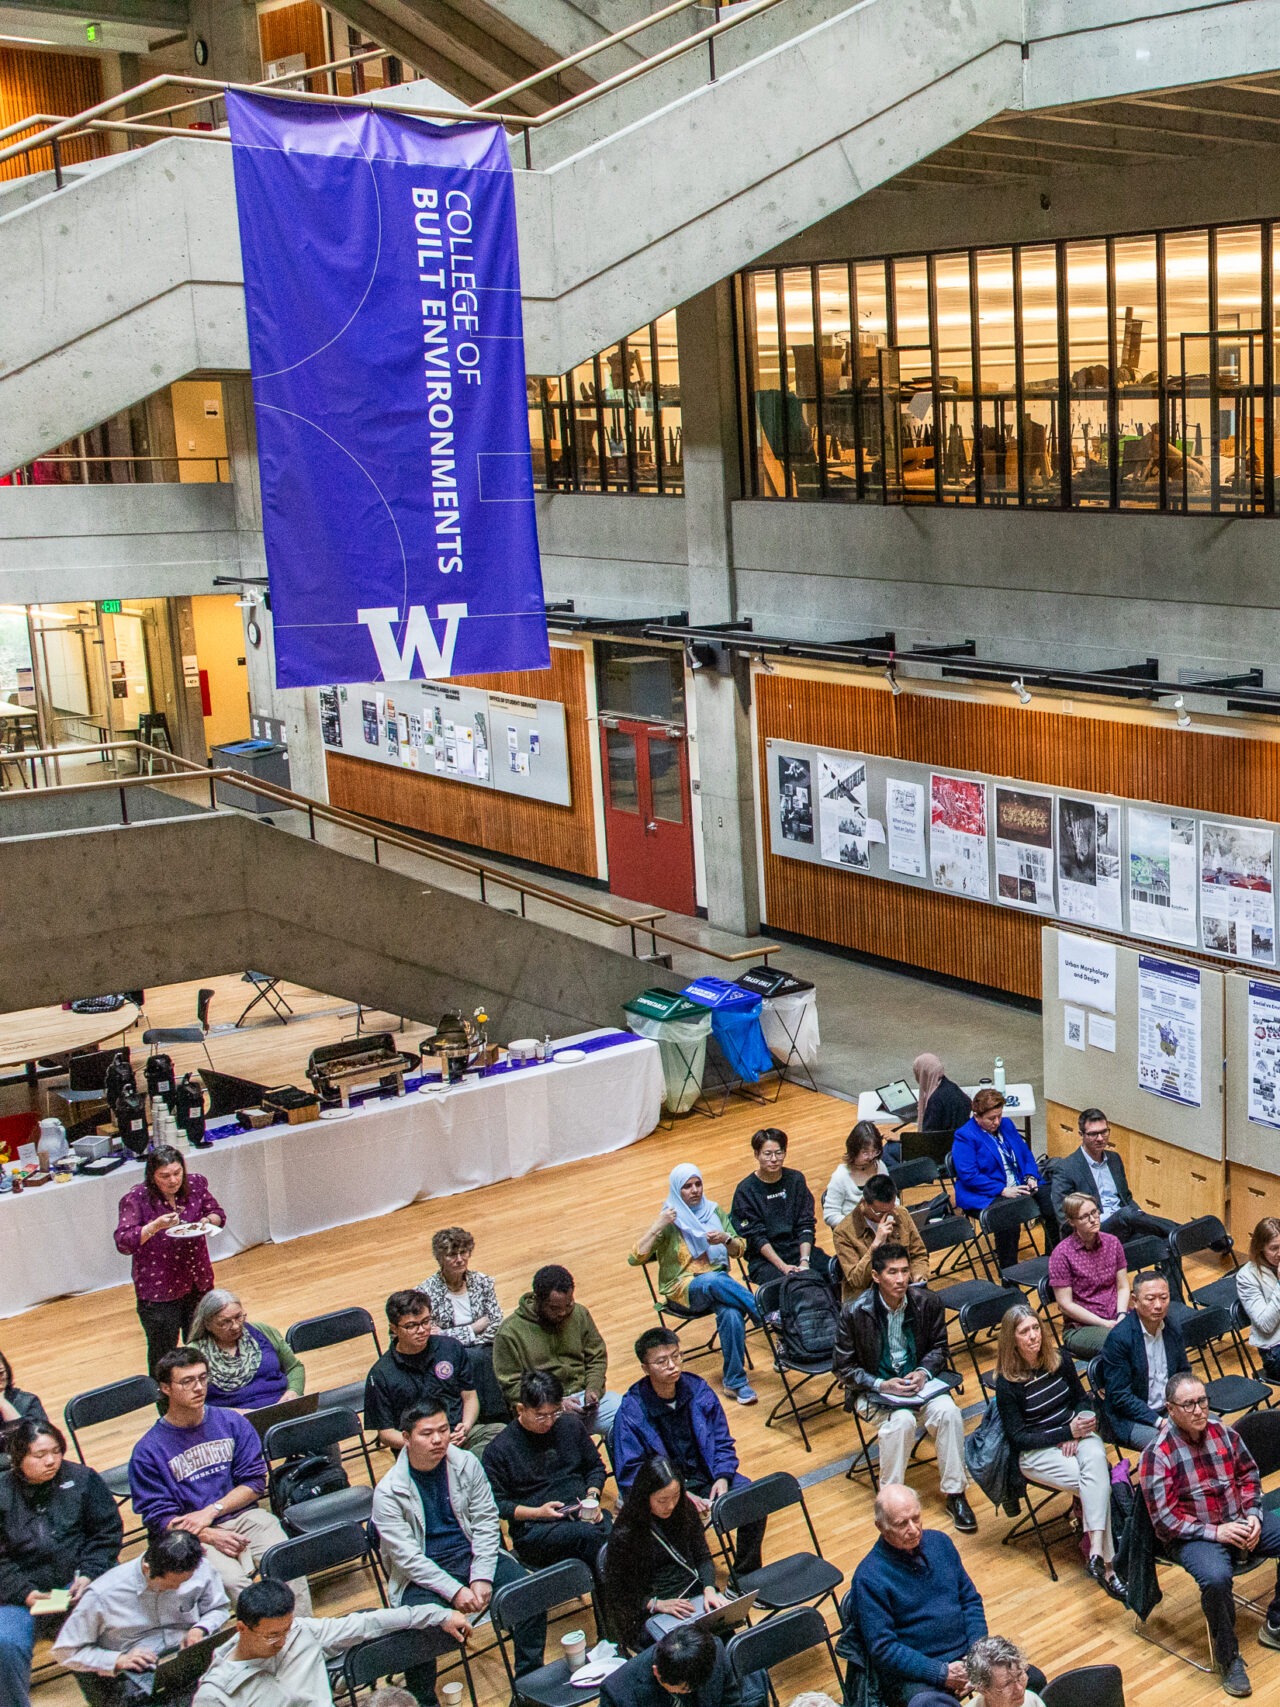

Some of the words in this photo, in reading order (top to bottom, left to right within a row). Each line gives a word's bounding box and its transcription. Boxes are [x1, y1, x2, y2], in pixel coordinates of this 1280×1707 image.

[411, 187, 446, 286] BUILT
[445, 189, 479, 332] COLLEGE
[456, 342, 481, 386] OF
[421, 298, 464, 575] ENVIRONMENTS
[104, 600, 120, 613] EXIT
[357, 602, 468, 682] W
[743, 975, 760, 984] TRASH
[758, 980, 773, 988] ONLY
[1065, 959, 1079, 970] Urban
[1080, 963, 1109, 978] Morphology
[1073, 972, 1084, 980] and
[1084, 974, 1100, 984] Design
[167, 1438, 235, 1482] WASHINGTON
[189, 1466, 226, 1482] HUSKIES
